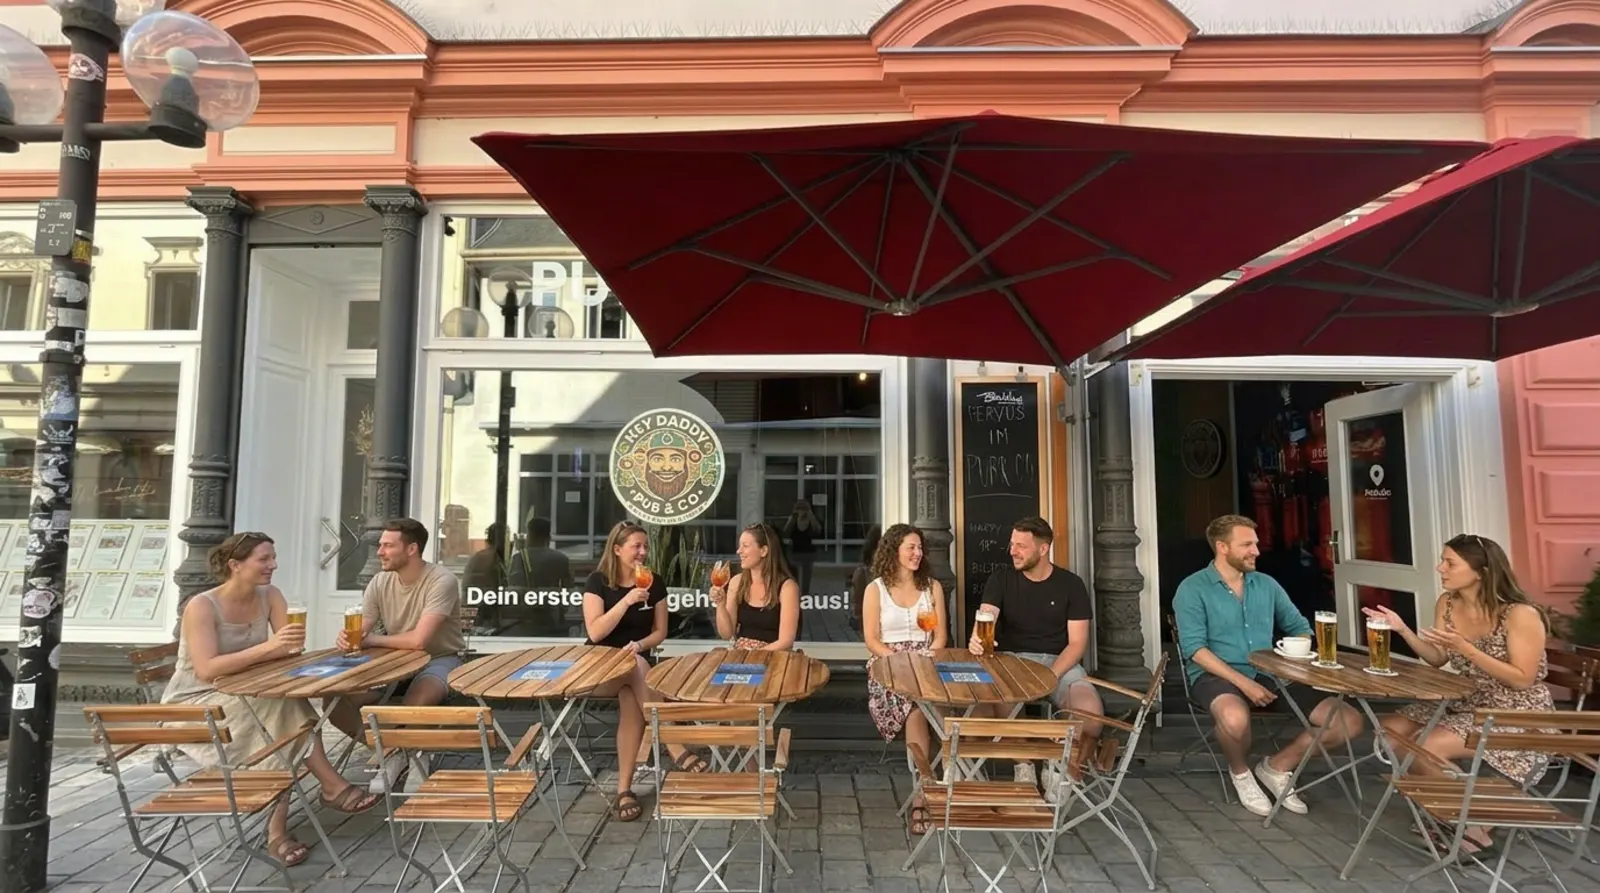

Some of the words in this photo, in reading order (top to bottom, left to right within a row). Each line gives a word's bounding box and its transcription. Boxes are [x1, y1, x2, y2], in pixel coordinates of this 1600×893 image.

[624, 417, 652, 443] HEY
[656, 415, 710, 443] DADDY
[632, 491, 660, 513] PUB
[466, 586, 518, 605] Dein
[524, 587, 583, 606] erste
[667, 589, 718, 612] geh
